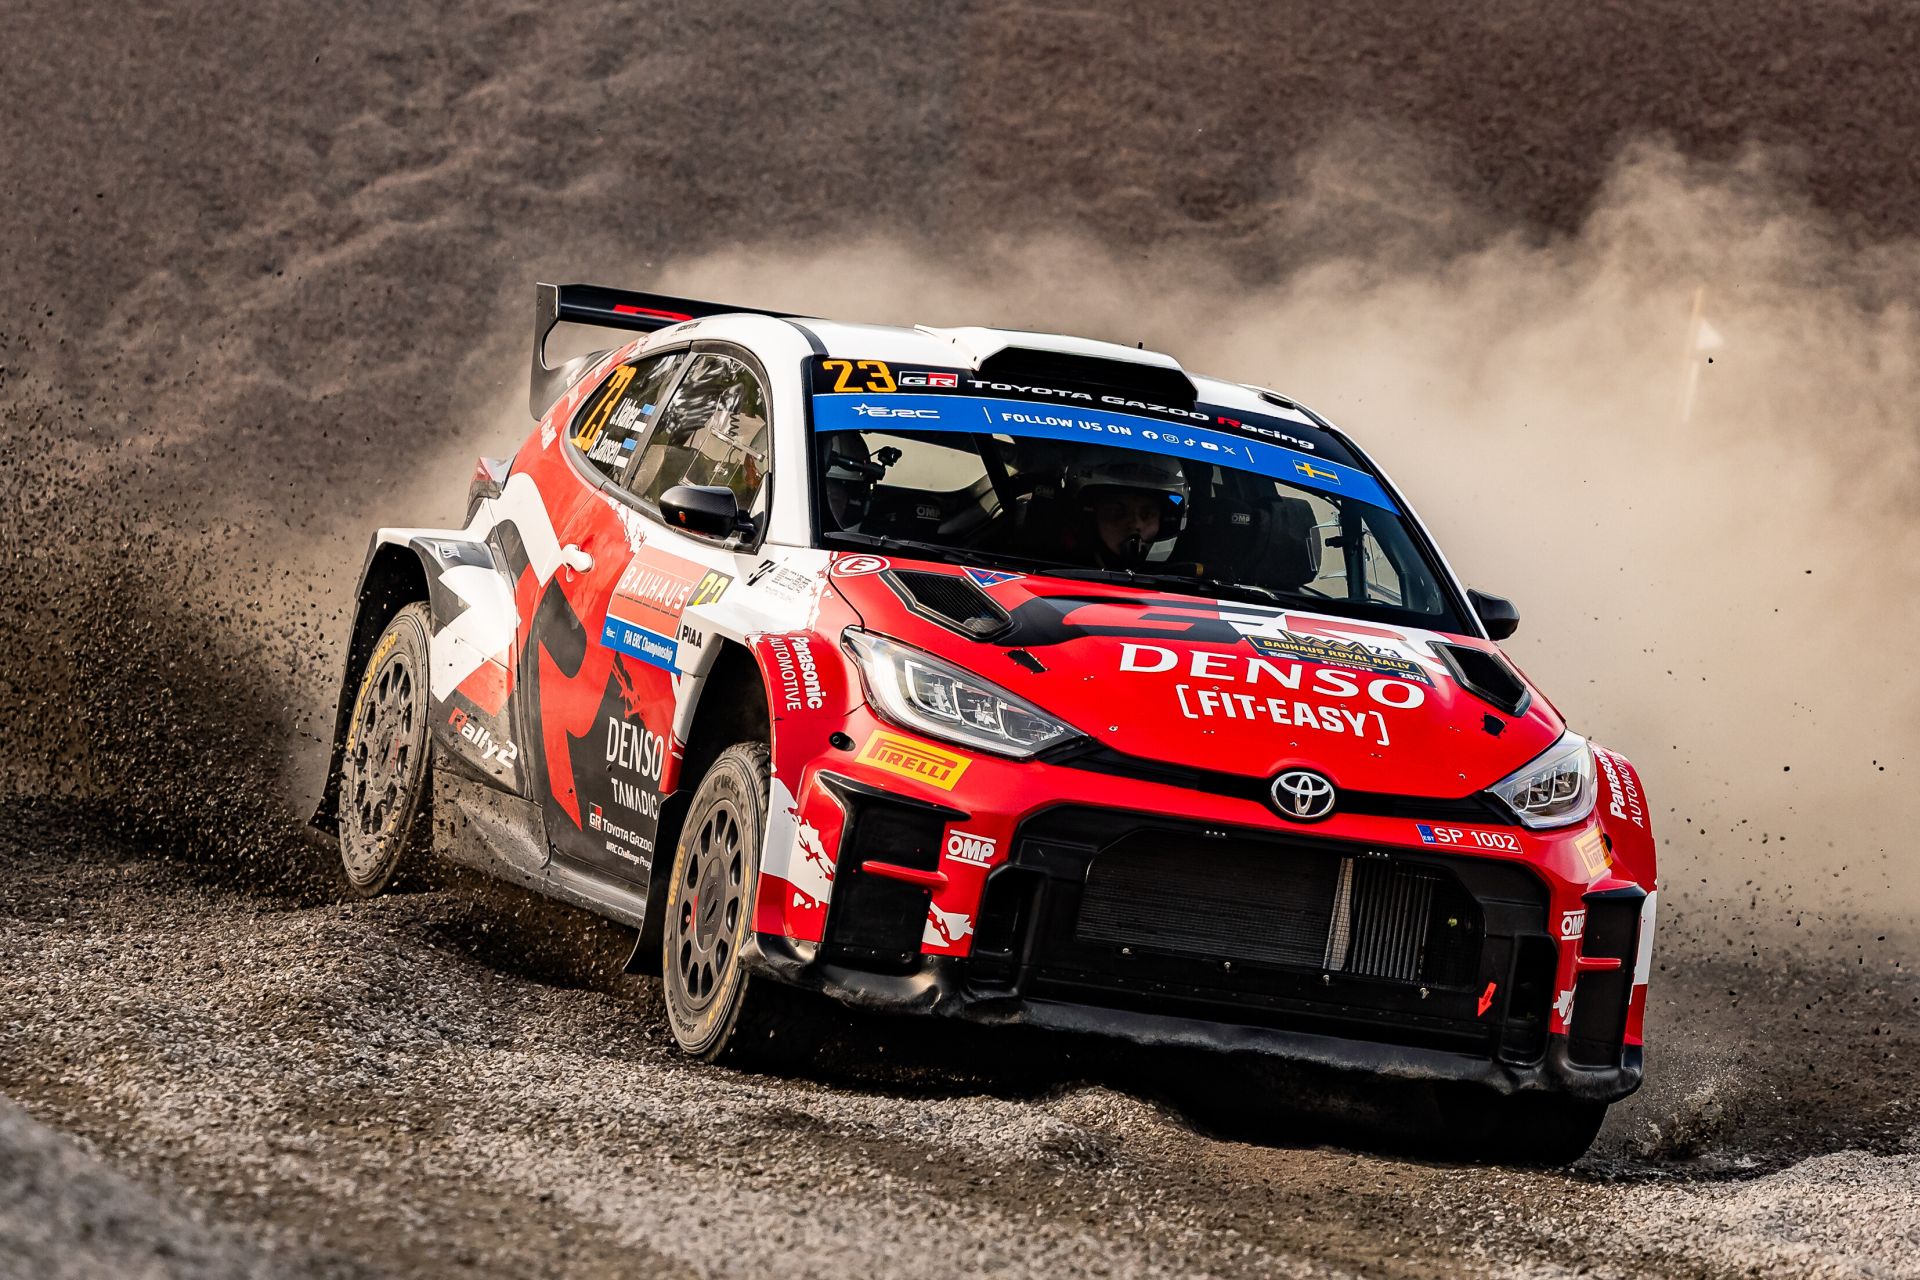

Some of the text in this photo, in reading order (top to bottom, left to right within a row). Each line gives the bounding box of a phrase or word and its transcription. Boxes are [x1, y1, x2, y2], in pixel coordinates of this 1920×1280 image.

[823, 360, 897, 393] 23
[570, 364, 637, 451] 23
[862, 406, 941, 419] ERC
[902, 376, 1315, 450] GR TOYOTA GAZOO Racing
[1001, 413, 1133, 436] FOLLOW US ON
[845, 558, 876, 571] E
[621, 566, 691, 610] BAUHAUS
[623, 629, 673, 664] FIA ERC Championship
[682, 625, 703, 649] PIAA
[1264, 640, 1325, 655] BAUHAUS
[1328, 649, 1369, 663] ROYAL
[1372, 657, 1410, 670] RALLY
[767, 637, 802, 711] AUTOMOTIVE
[788, 636, 827, 710] Panasonic
[1119, 642, 1425, 709] DENSO
[606, 716, 664, 782] DENSO
[867, 738, 958, 781] PIRELLI
[611, 777, 658, 820] TAMADIC
[590, 811, 653, 852] GR TOYOTA GAZOO
[947, 832, 995, 865] OMP
[1434, 827, 1463, 844] SP
[1470, 831, 1519, 851] 1002
[617, 846, 640, 866] Challenge
[1561, 912, 1585, 938] OMP
